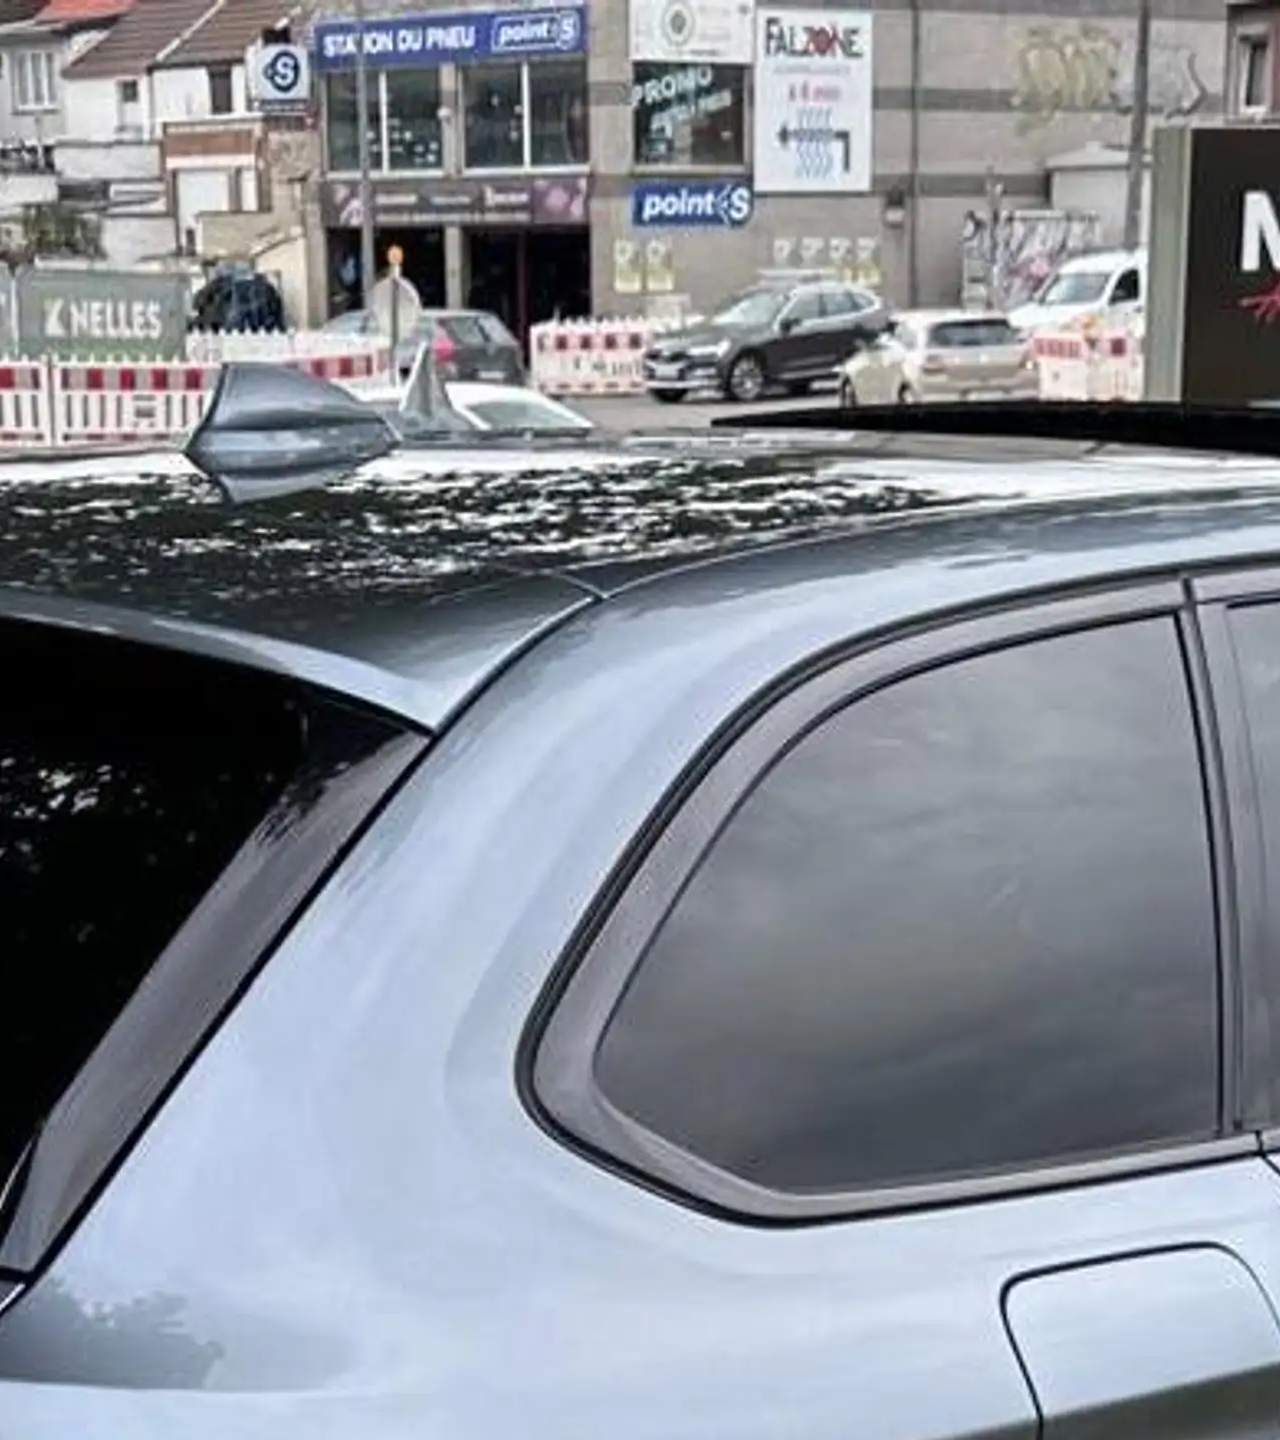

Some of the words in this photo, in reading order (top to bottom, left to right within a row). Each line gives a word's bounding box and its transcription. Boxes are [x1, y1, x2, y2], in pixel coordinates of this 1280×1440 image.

[323, 31, 393, 58] STAION
[397, 28, 422, 53] DU
[425, 25, 476, 50] PNEU
[632, 65, 713, 108] PROMO
[642, 189, 716, 222] point
[70, 298, 164, 340] NELLES
